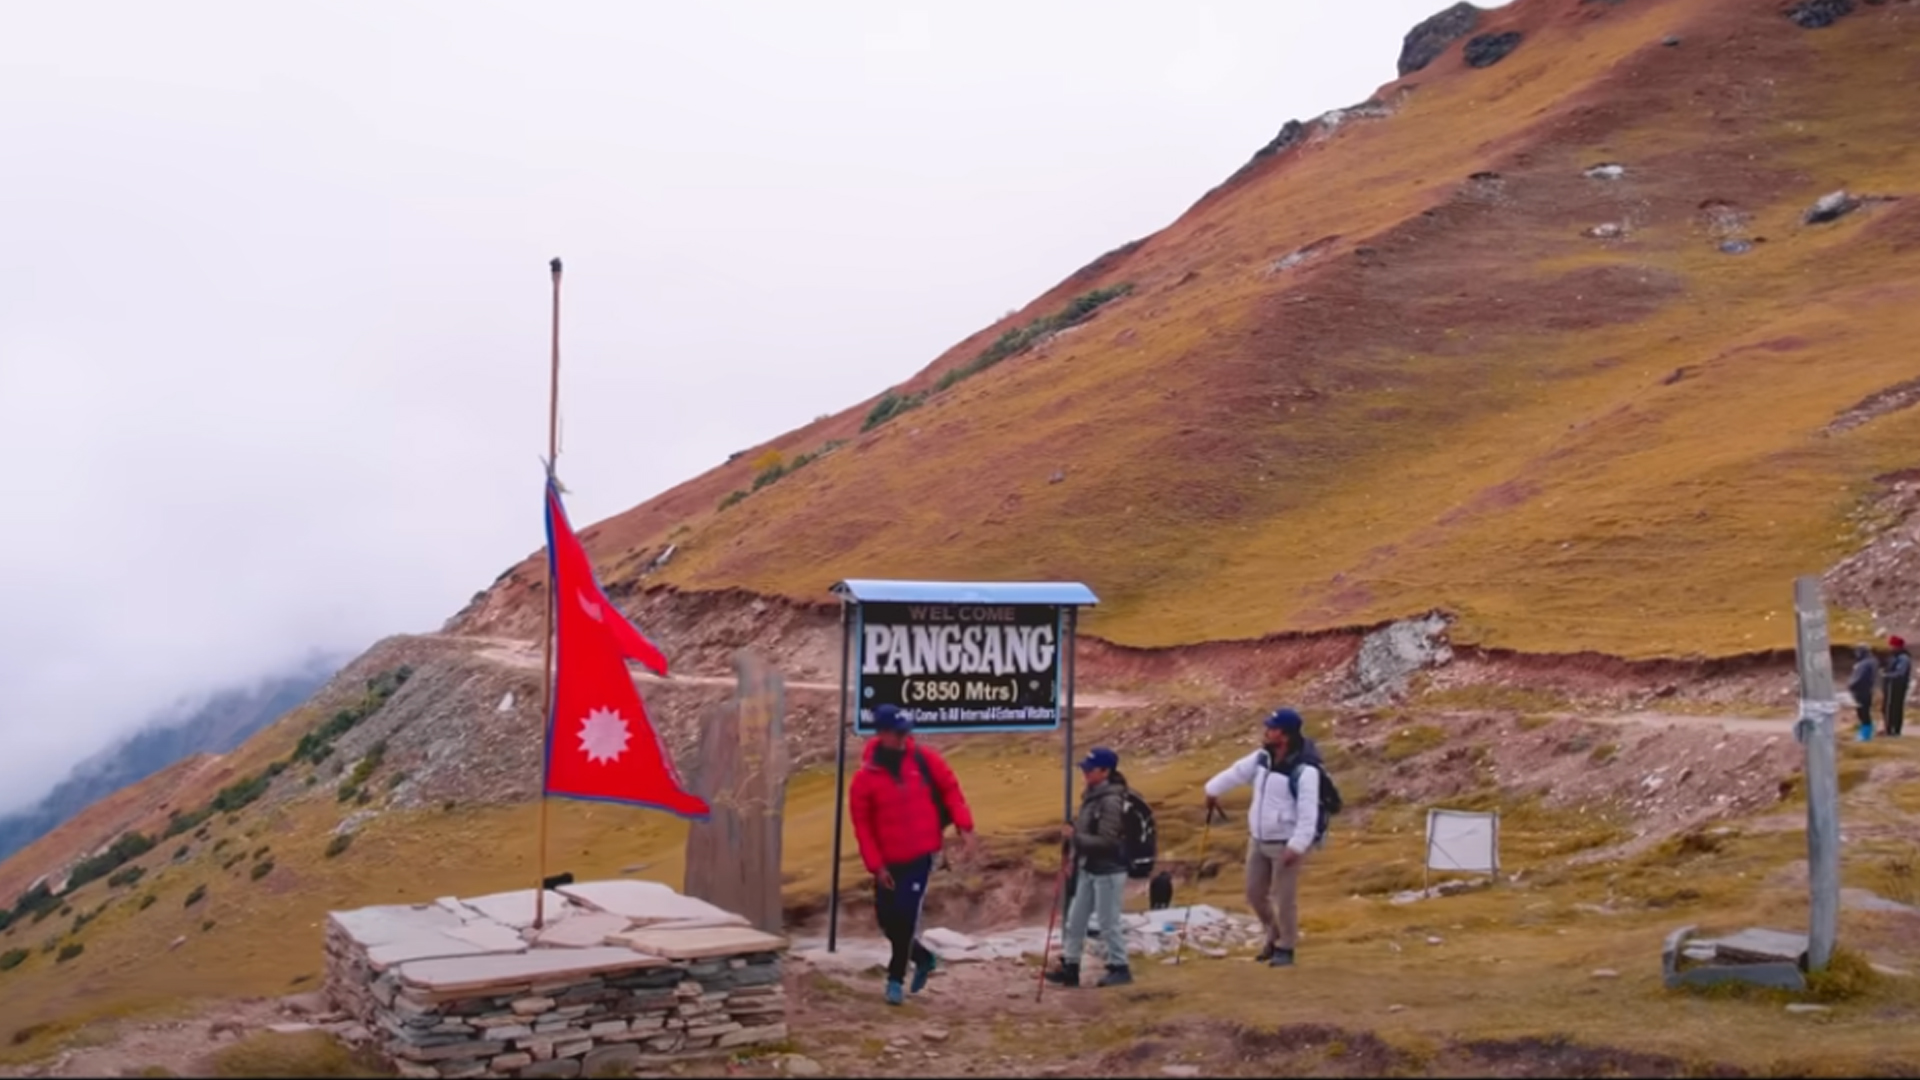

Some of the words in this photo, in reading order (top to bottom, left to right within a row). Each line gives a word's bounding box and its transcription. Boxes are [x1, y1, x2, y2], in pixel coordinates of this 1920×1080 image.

[862, 624, 1055, 676] PANGSANG
[901, 679, 960, 703] (3850
[965, 679, 1018, 702] Mtrs)
